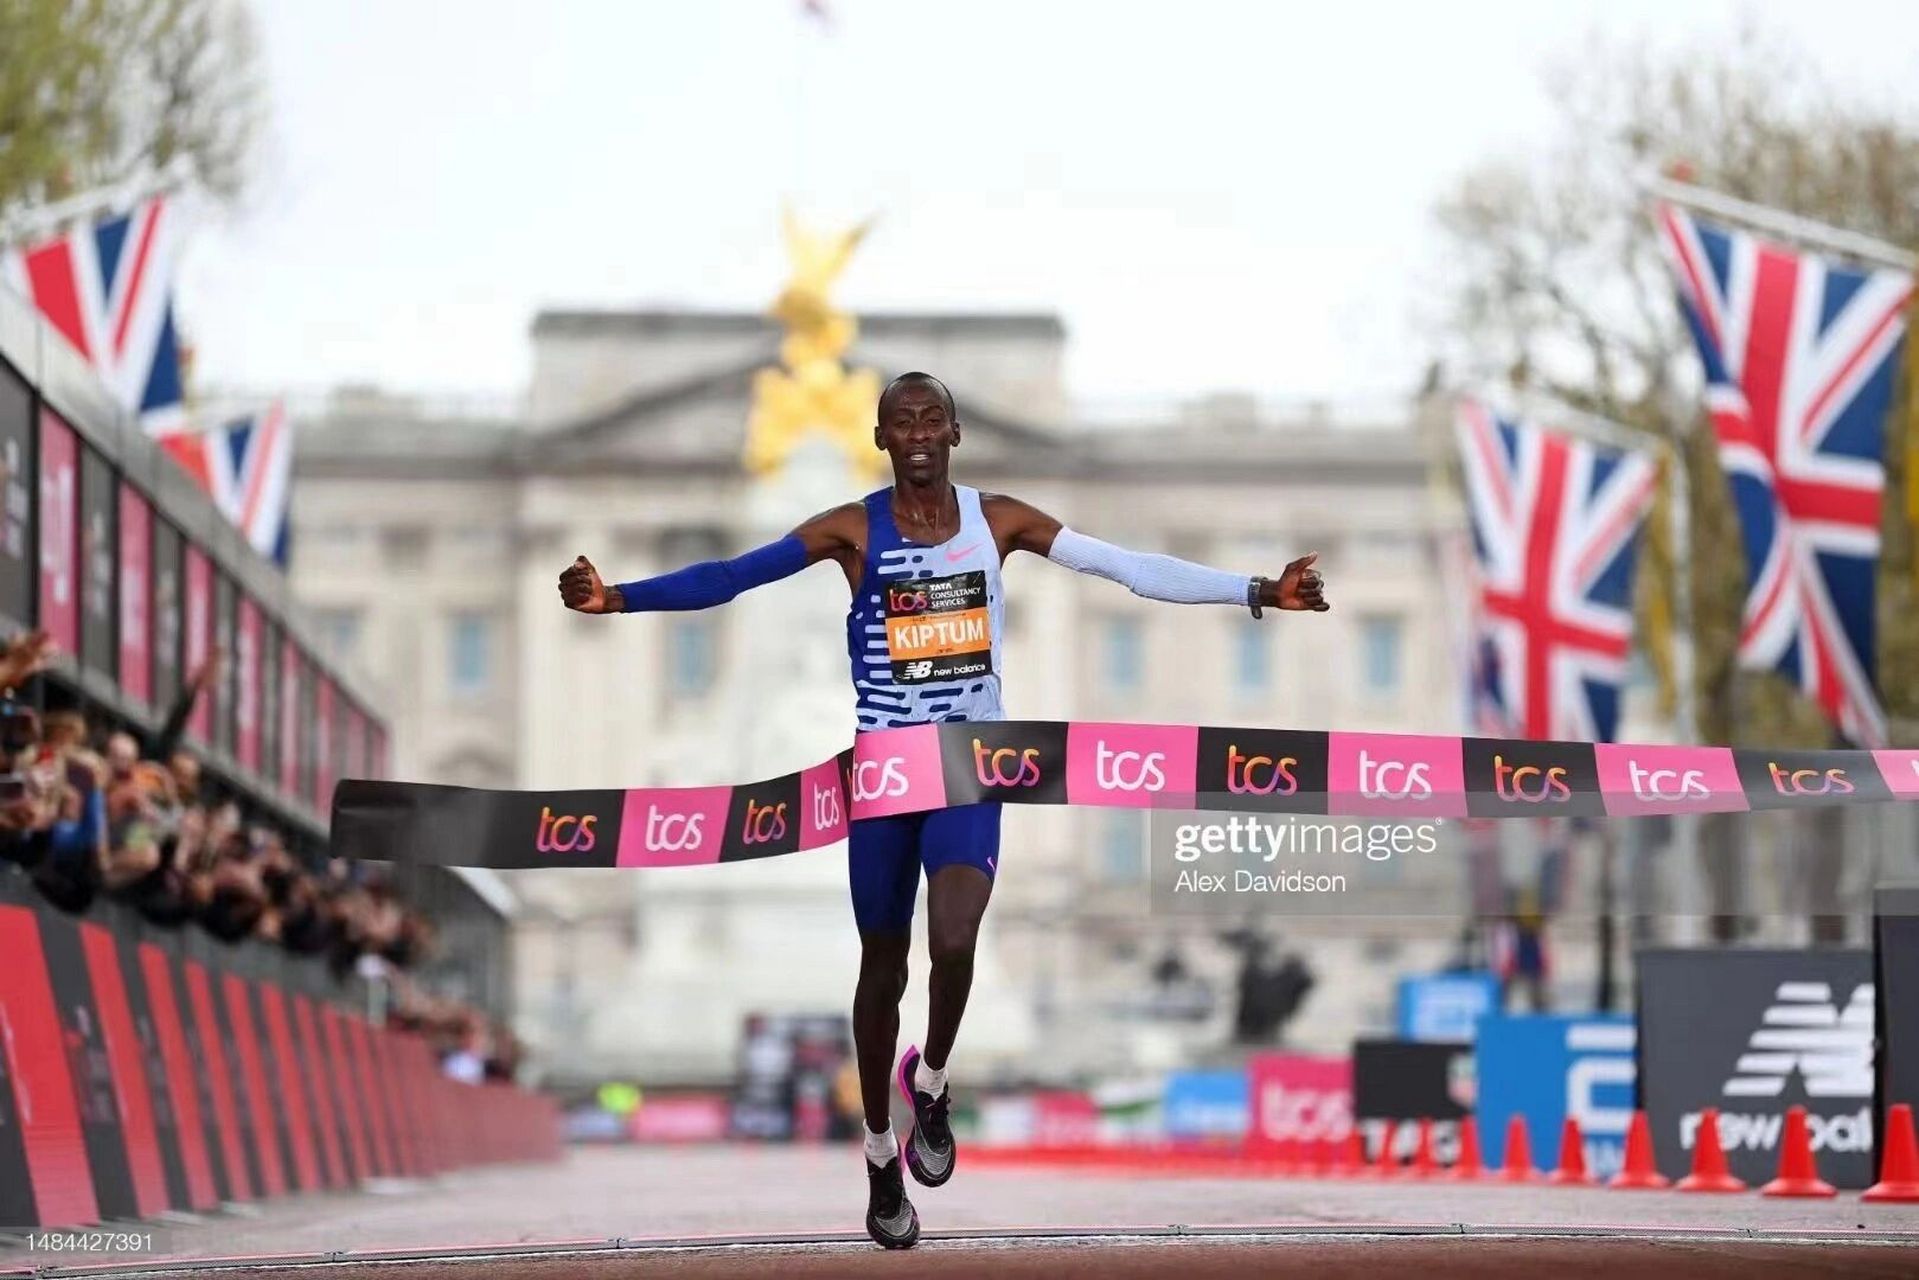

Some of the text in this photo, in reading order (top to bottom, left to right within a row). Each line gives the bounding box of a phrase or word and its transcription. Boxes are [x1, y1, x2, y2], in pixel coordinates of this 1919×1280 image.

[929, 582, 953, 591] TATA
[930, 587, 981, 600] CONSULTANCY
[889, 588, 928, 612] tcs
[931, 598, 966, 608] SERVICES
[894, 617, 984, 649] KIPTUM
[933, 668, 953, 677] new
[953, 663, 986, 675] balance
[851, 738, 1855, 803] tcs tcs tcs tcs tcs tcs tcs tcs
[536, 782, 840, 853] tcs tcs tcs tcs
